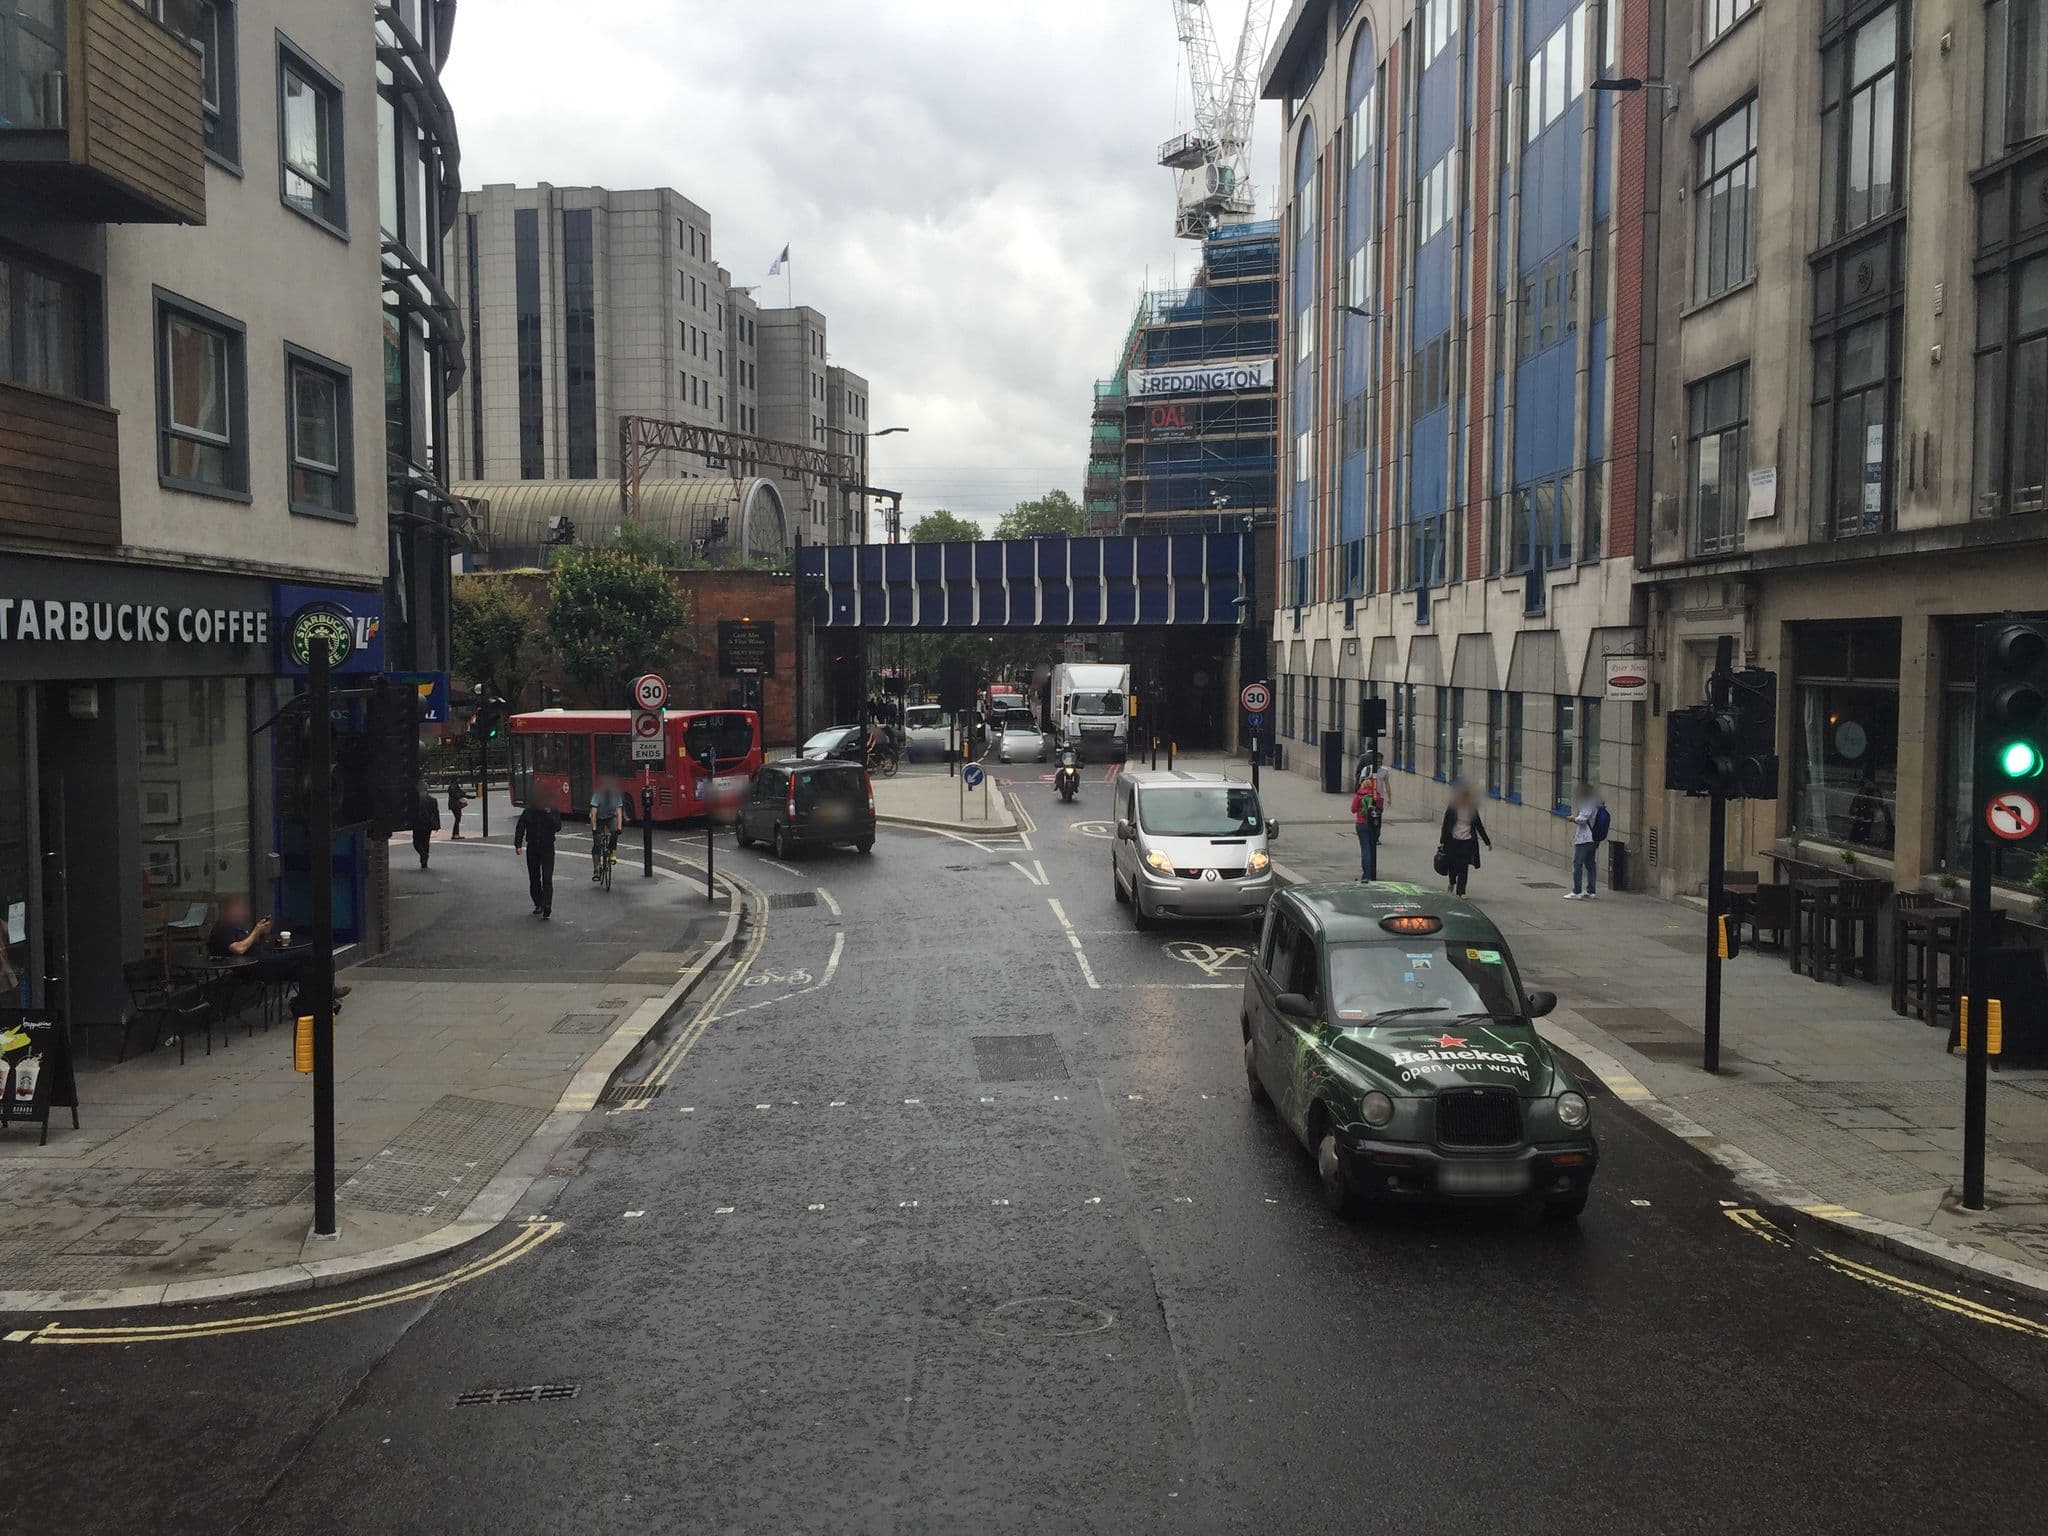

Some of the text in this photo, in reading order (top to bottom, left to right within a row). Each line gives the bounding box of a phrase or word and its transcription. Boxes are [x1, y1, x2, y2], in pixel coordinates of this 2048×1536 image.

[1140, 369, 1261, 393] J.REDDINGTON
[0, 599, 267, 643] TARBUCKS COFFEE
[296, 614, 348, 640] STARBUCKS
[301, 650, 342, 665] CEE
[642, 686, 662, 699] 30
[1247, 693, 1265, 704] 30
[636, 750, 661, 758] ENDS
[1395, 917, 1432, 930] TAXI
[1389, 1050, 1527, 1067] Heineken
[1401, 1062, 1531, 1082] open your world
